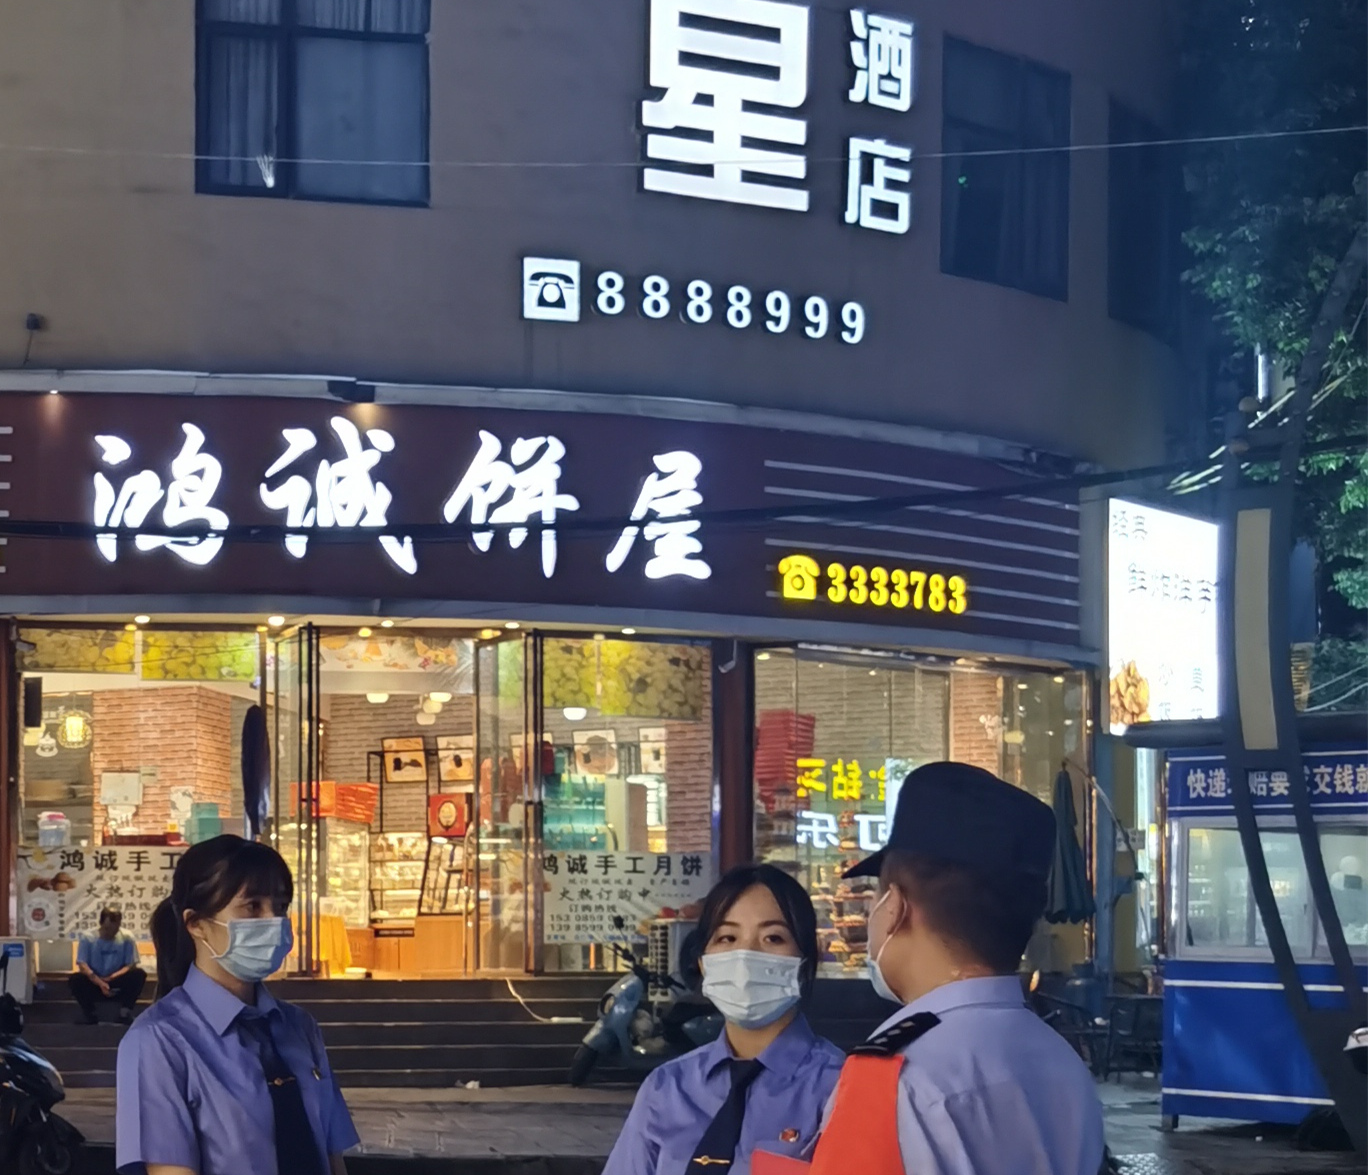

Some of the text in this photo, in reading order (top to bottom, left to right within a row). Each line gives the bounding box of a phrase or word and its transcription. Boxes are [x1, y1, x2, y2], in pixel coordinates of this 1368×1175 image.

[642, 0, 810, 212] 星
[845, 9, 914, 234] 酒店
[596, 271, 866, 344] 8888999
[93, 416, 713, 580] 鸿诚饼屋
[826, 562, 968, 614] 3333783
[543, 854, 702, 876] 鸿诚手工月饼
